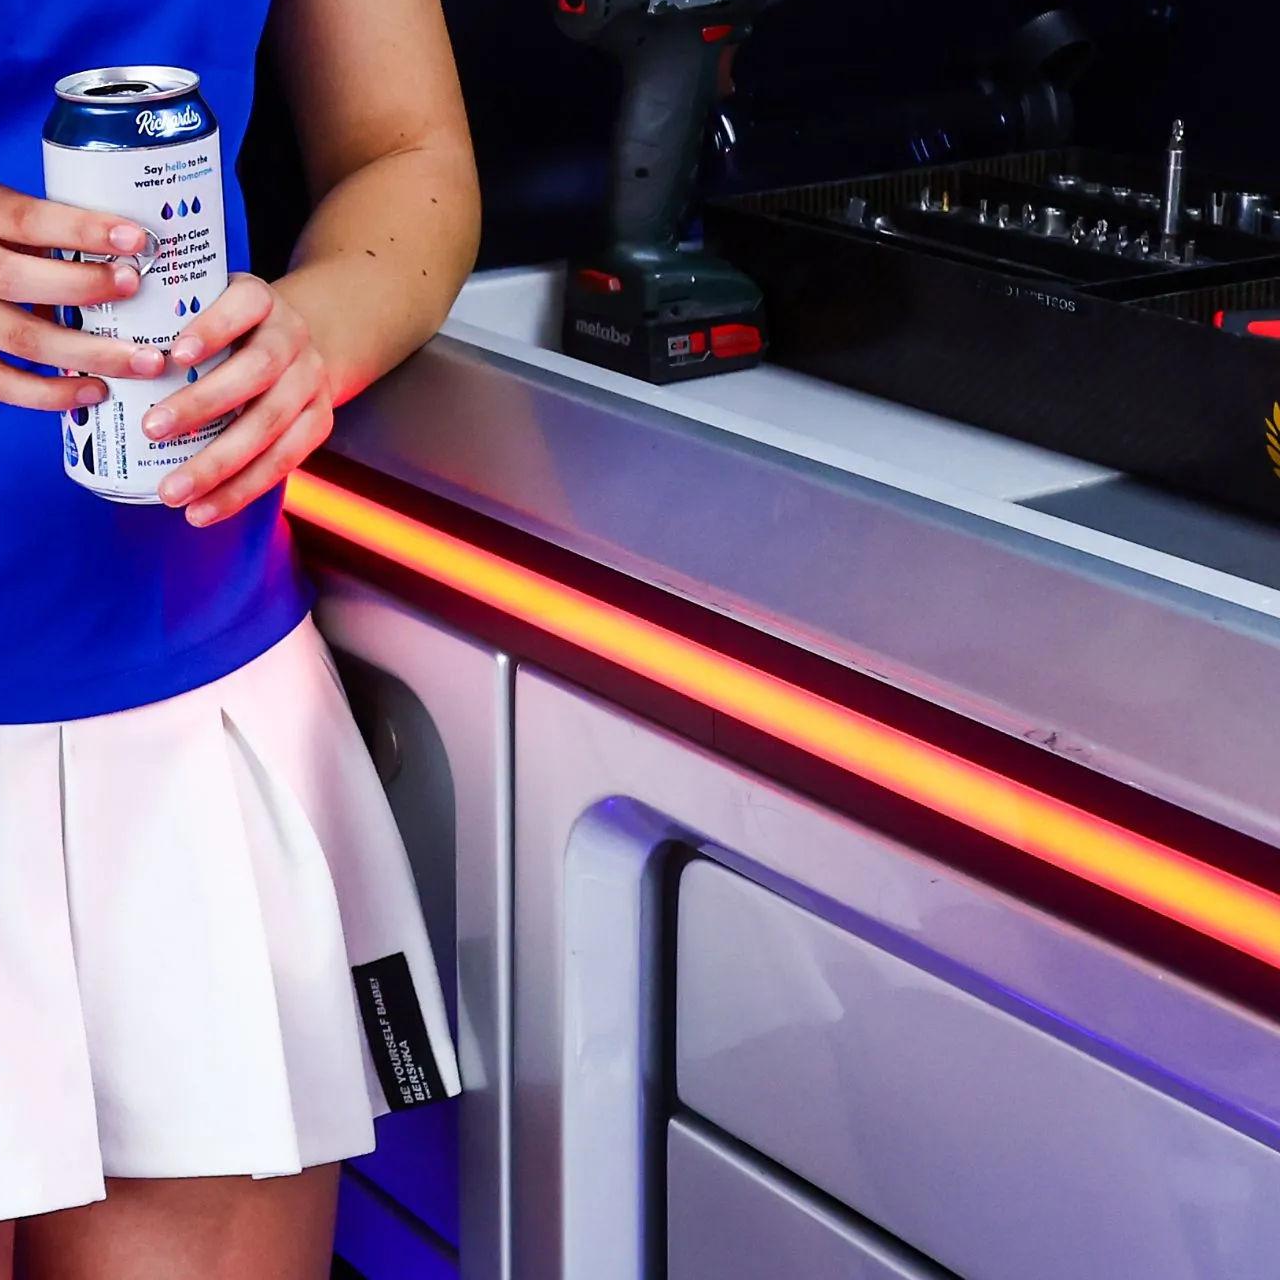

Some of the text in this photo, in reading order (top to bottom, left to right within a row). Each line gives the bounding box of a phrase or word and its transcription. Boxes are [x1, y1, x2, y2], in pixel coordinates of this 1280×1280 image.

[144, 155, 208, 176] Say hello to the
[134, 177, 165, 189] water
[166, 175, 176, 185] of
[158, 228, 210, 246] aught Clean
[158, 241, 210, 259] ottled Fresh
[172, 253, 217, 272] Everywhere
[162, 270, 208, 286] 100% Rain
[132, 335, 150, 344] We
[152, 335, 170, 344] can
[575, 317, 632, 348] metabo
[380, 1018, 407, 1084] YOURSELF
[399, 1040, 425, 1101] BERSHKA
[400, 1086, 413, 1104] BE
